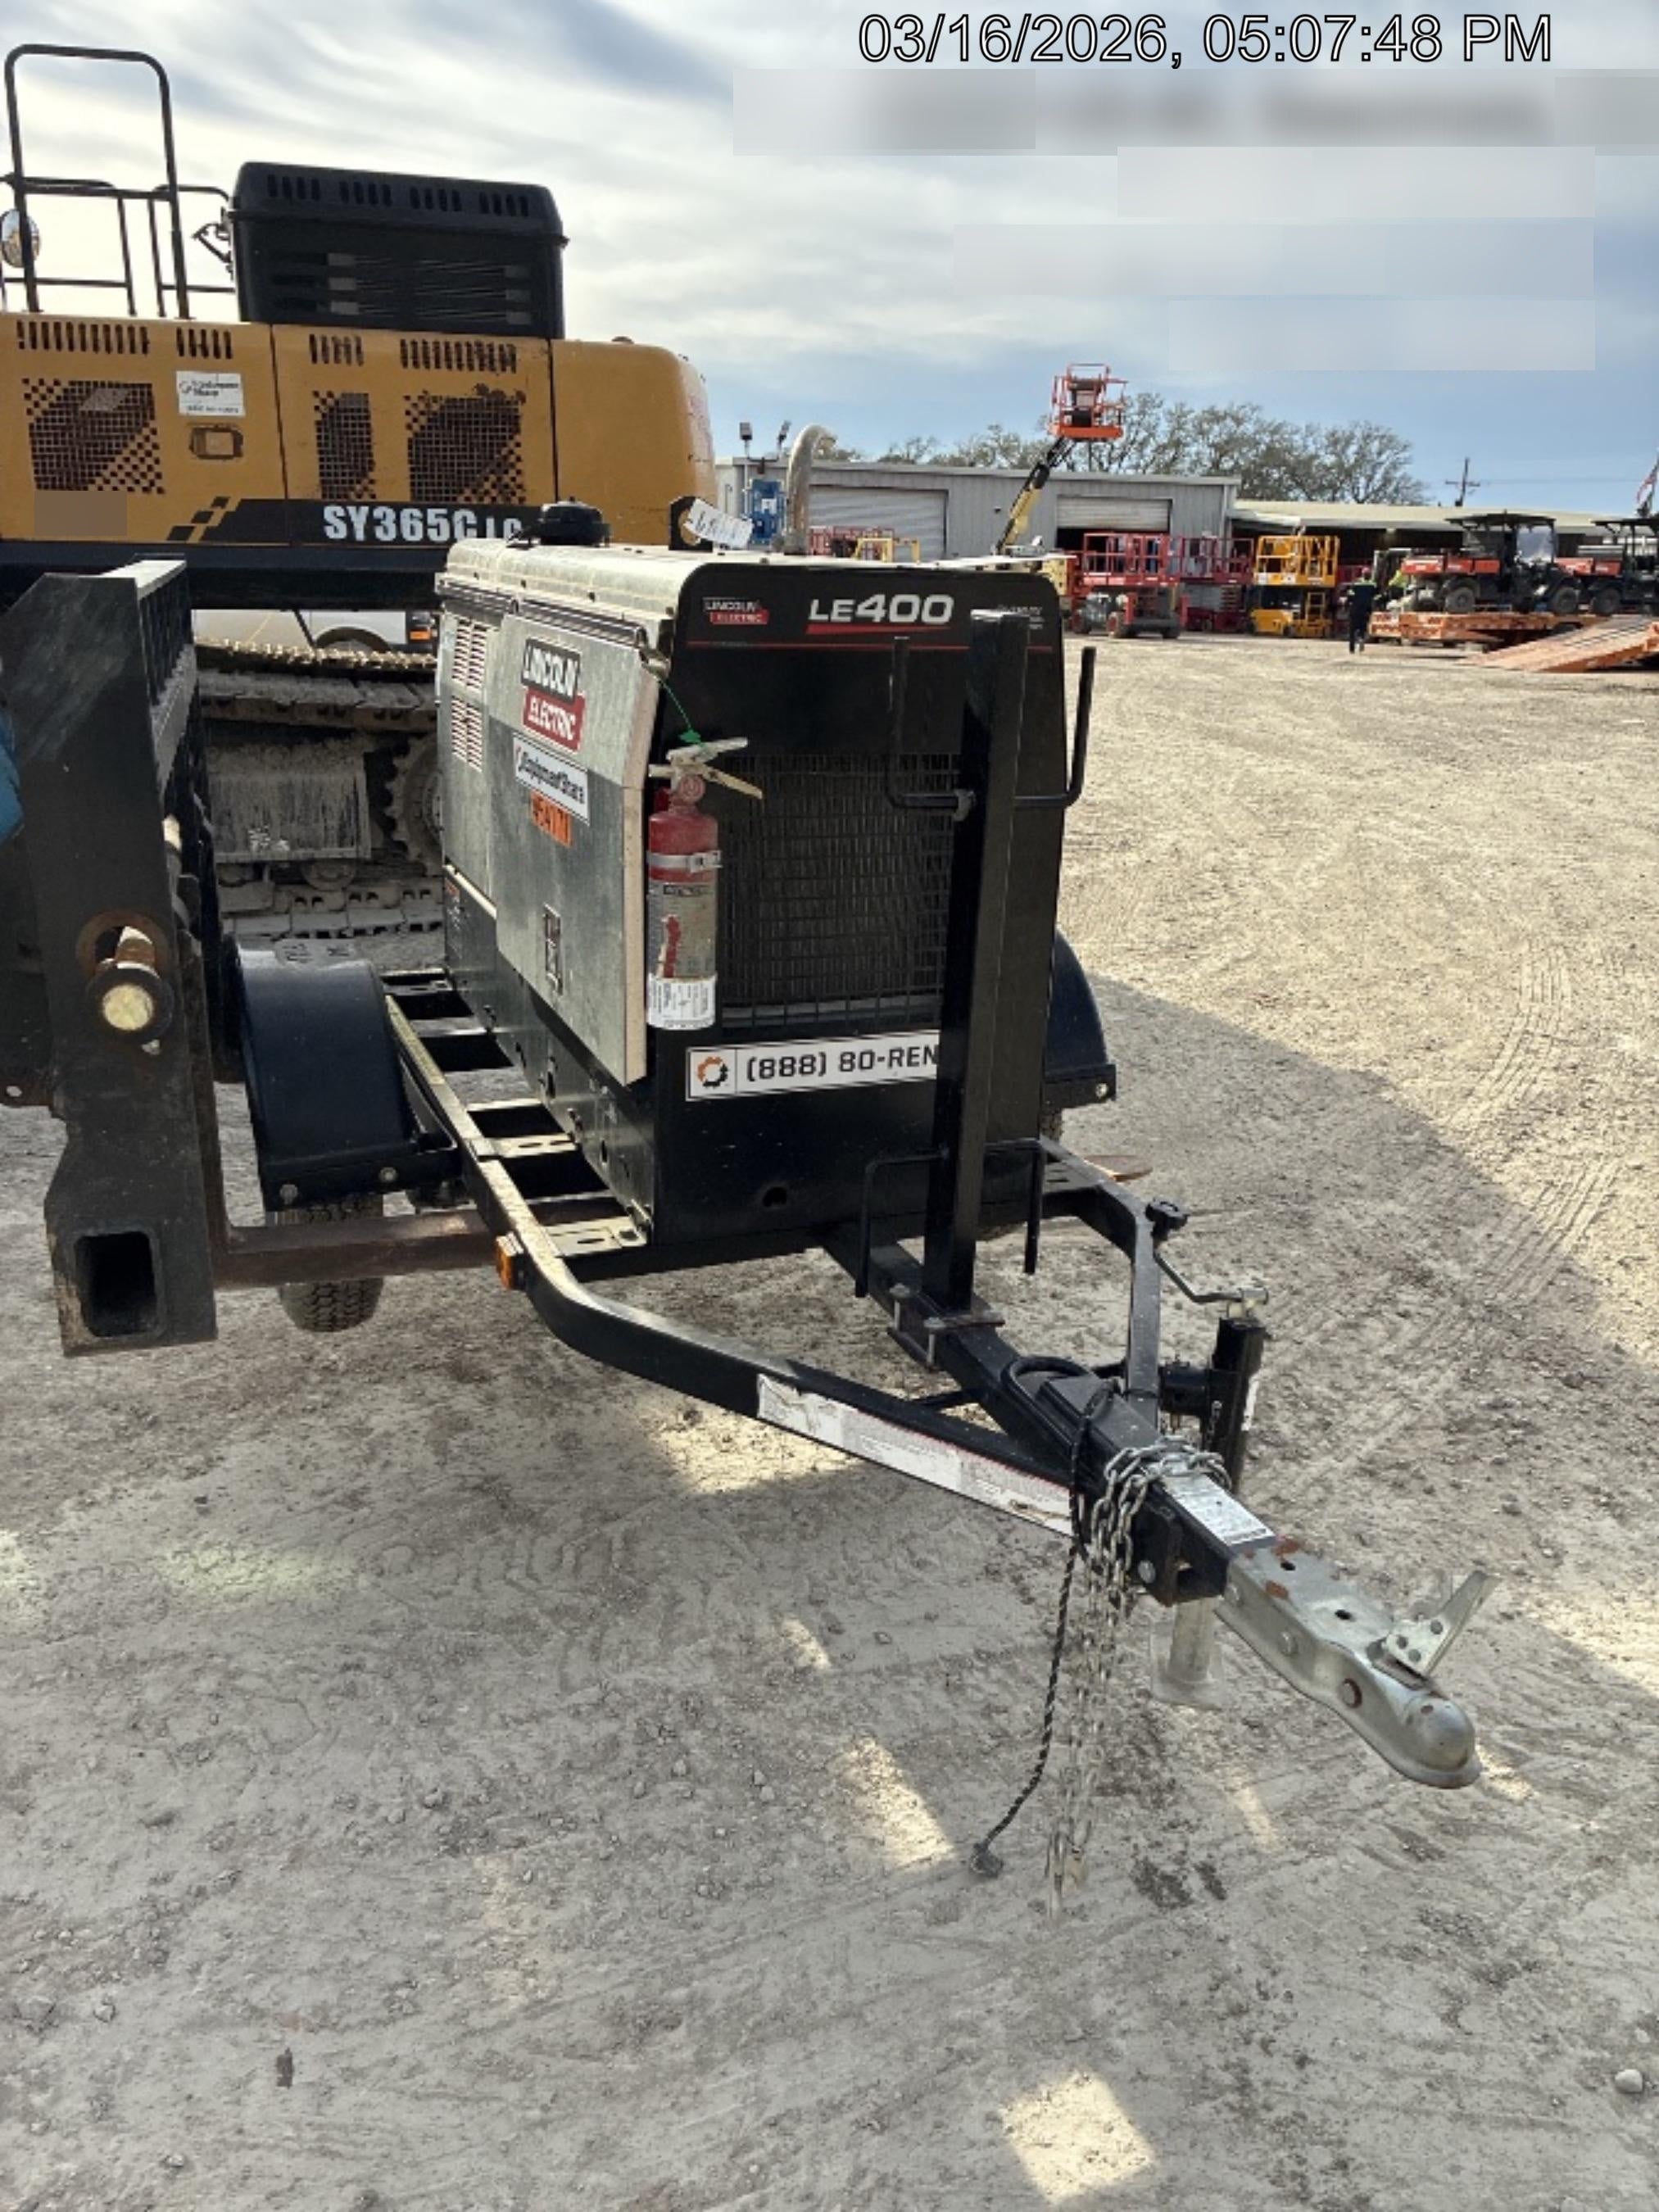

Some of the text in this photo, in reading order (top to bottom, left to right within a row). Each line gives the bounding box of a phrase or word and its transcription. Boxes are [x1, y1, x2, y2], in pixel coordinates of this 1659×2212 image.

[704, 600, 757, 614] LINCOLN
[808, 593, 955, 625] LE400
[523, 643, 578, 700] LINCOLN
[527, 696, 577, 741] ELECTRIC
[746, 1050, 827, 1082] (888)
